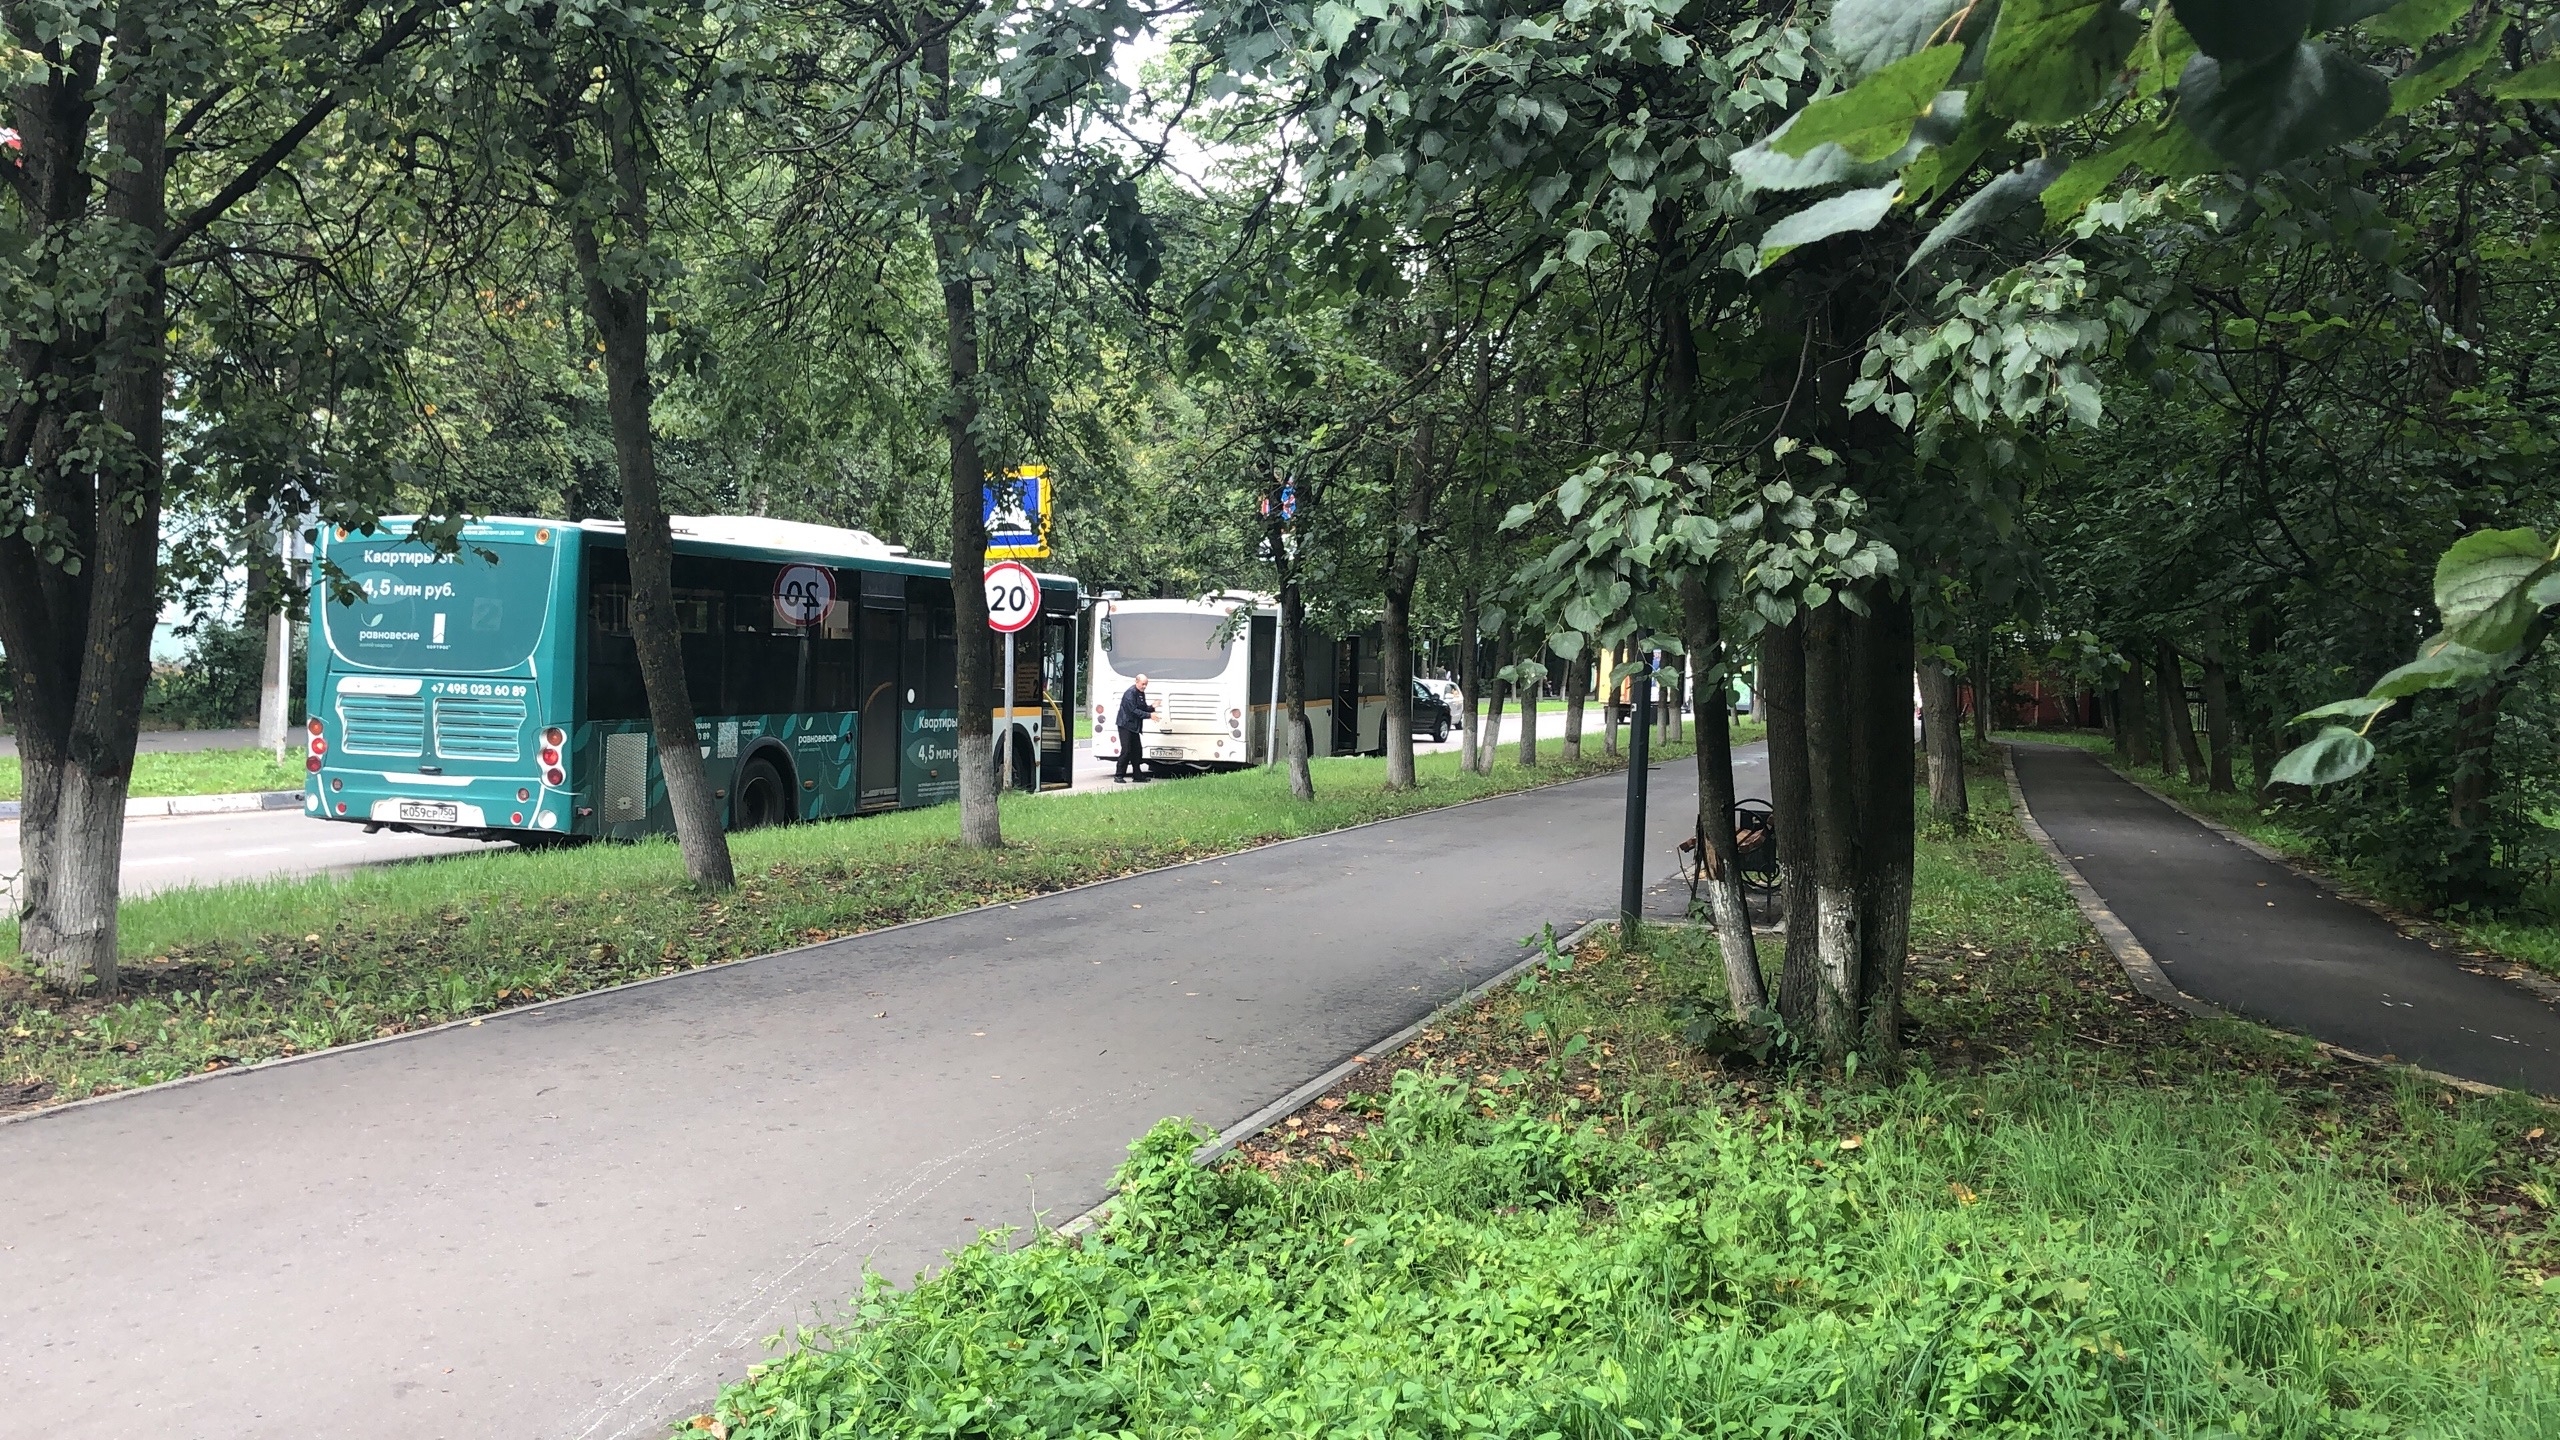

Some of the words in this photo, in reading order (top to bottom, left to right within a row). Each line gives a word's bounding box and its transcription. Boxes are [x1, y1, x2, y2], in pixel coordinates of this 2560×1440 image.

[364, 550, 434, 567] Квартиры
[362, 578, 391, 599] 4,5
[393, 584, 422, 596] млн
[424, 582, 456, 600] руб.
[990, 585, 1026, 612] 20
[359, 631, 420, 641] равновесие
[431, 682, 444, 694] +7
[446, 683, 468, 694] 495
[470, 683, 492, 696] 023
[494, 685, 509, 696] 60
[512, 685, 527, 697] 89
[919, 716, 958, 732] Квартиры
[798, 734, 837, 746] равновесие
[918, 744, 935, 763] 4,5
[936, 748, 951, 760] млн
